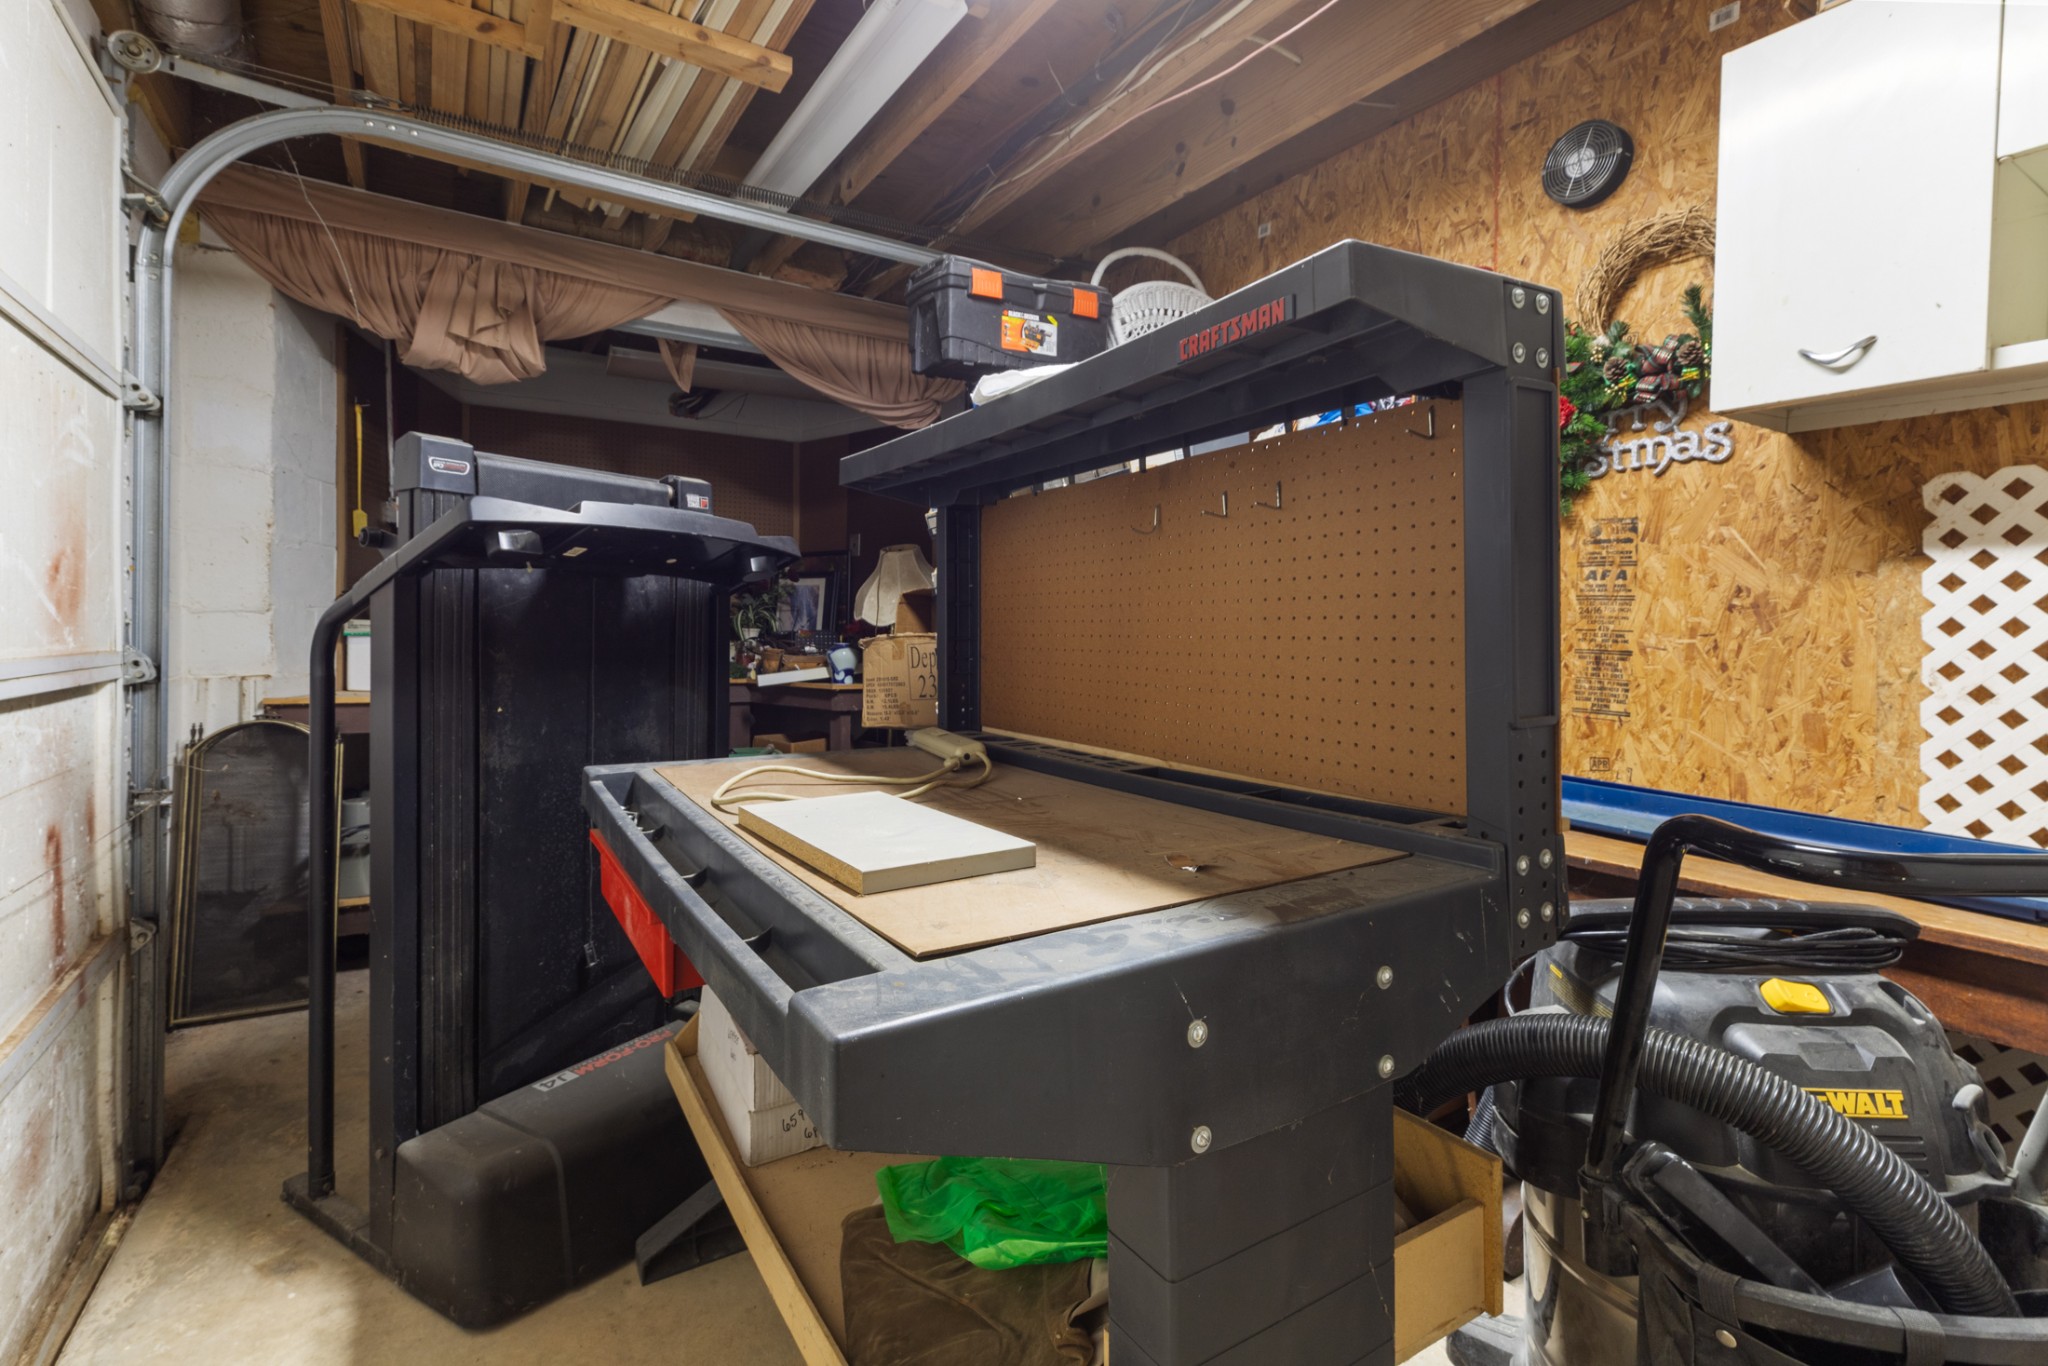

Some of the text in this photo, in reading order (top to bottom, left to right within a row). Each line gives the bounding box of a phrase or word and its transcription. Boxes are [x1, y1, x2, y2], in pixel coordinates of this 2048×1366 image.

[1179, 296, 1285, 361] CRAFTSMAN
[1584, 421, 1733, 476] stmas
[910, 646, 937, 674] Dep
[573, 1029, 674, 1076] PRO-FORM
[782, 1109, 805, 1132] 659
[1815, 1090, 1904, 1116] WALT
